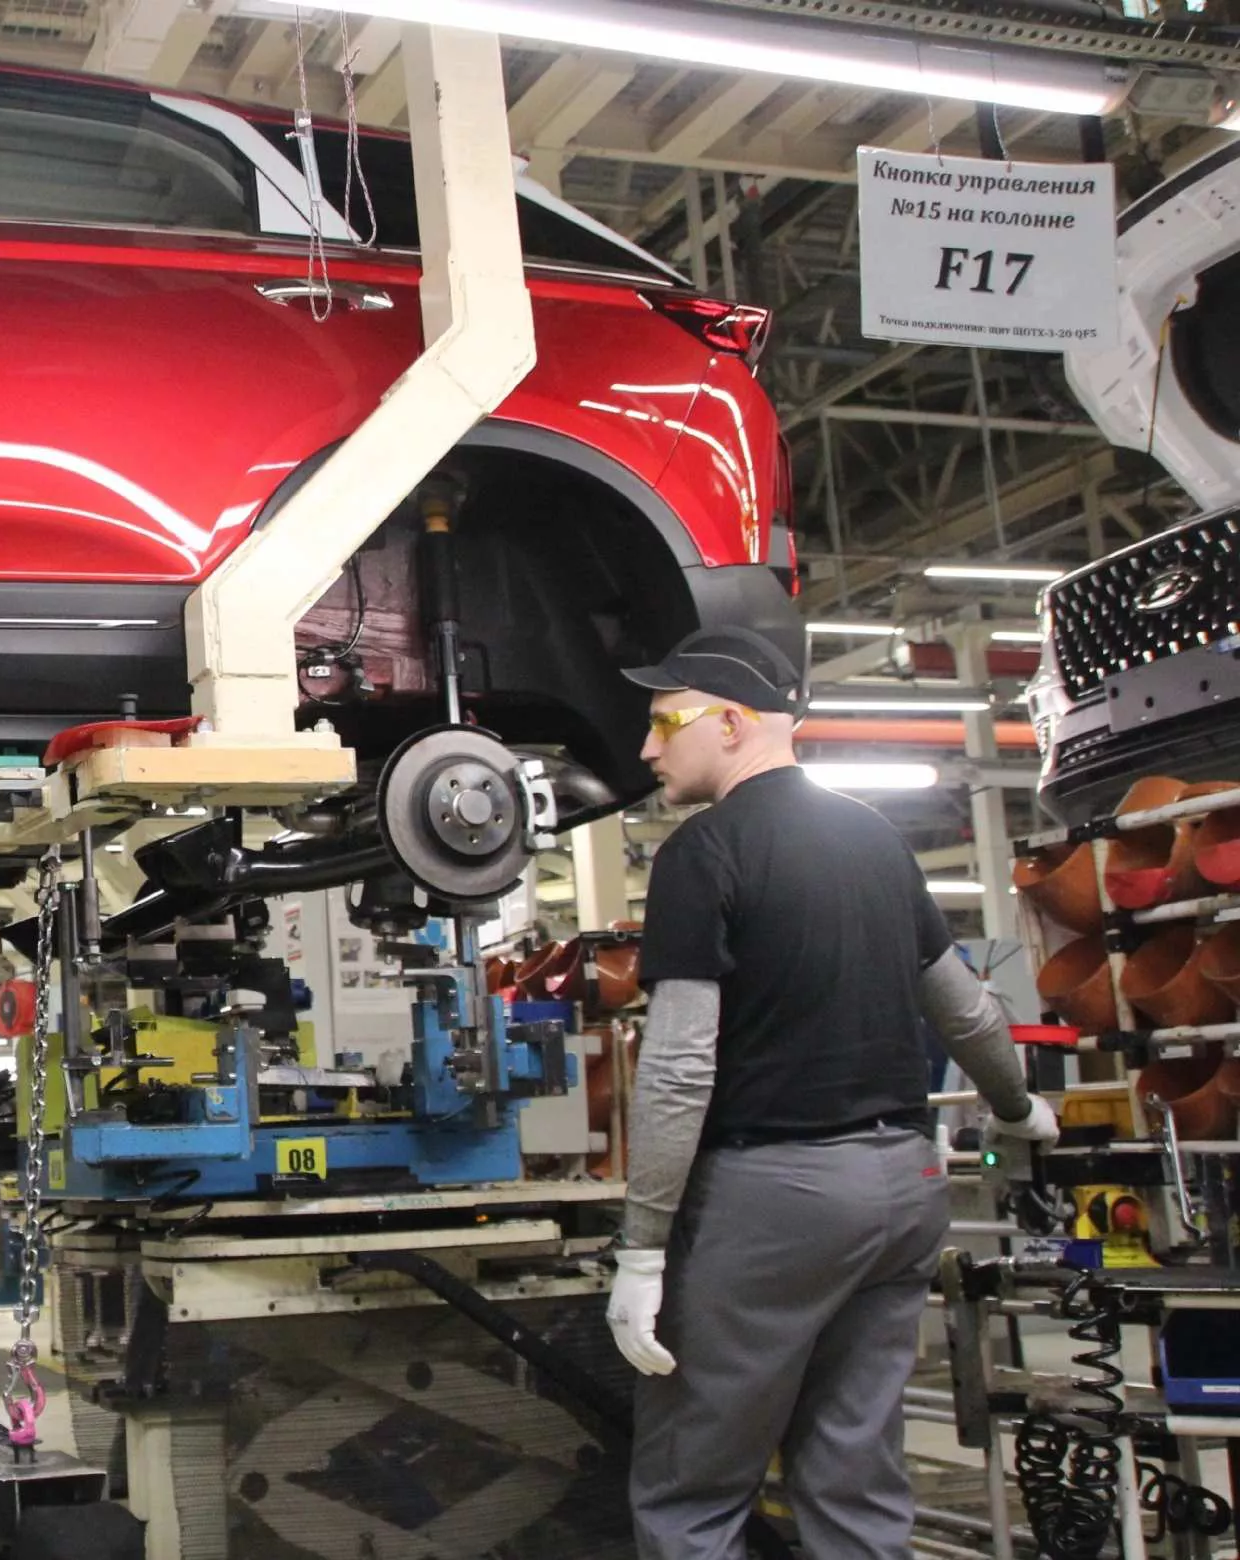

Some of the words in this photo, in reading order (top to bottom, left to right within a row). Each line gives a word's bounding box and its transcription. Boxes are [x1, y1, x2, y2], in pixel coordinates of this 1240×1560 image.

[873, 159, 952, 187] Кнопка
[956, 171, 1095, 195] управления
[890, 198, 942, 221] №15
[947, 208, 974, 223] на
[980, 210, 1075, 229] колонне
[934, 247, 1035, 296] F17
[879, 314, 909, 327] Точка
[288, 1148, 315, 1171] 08
